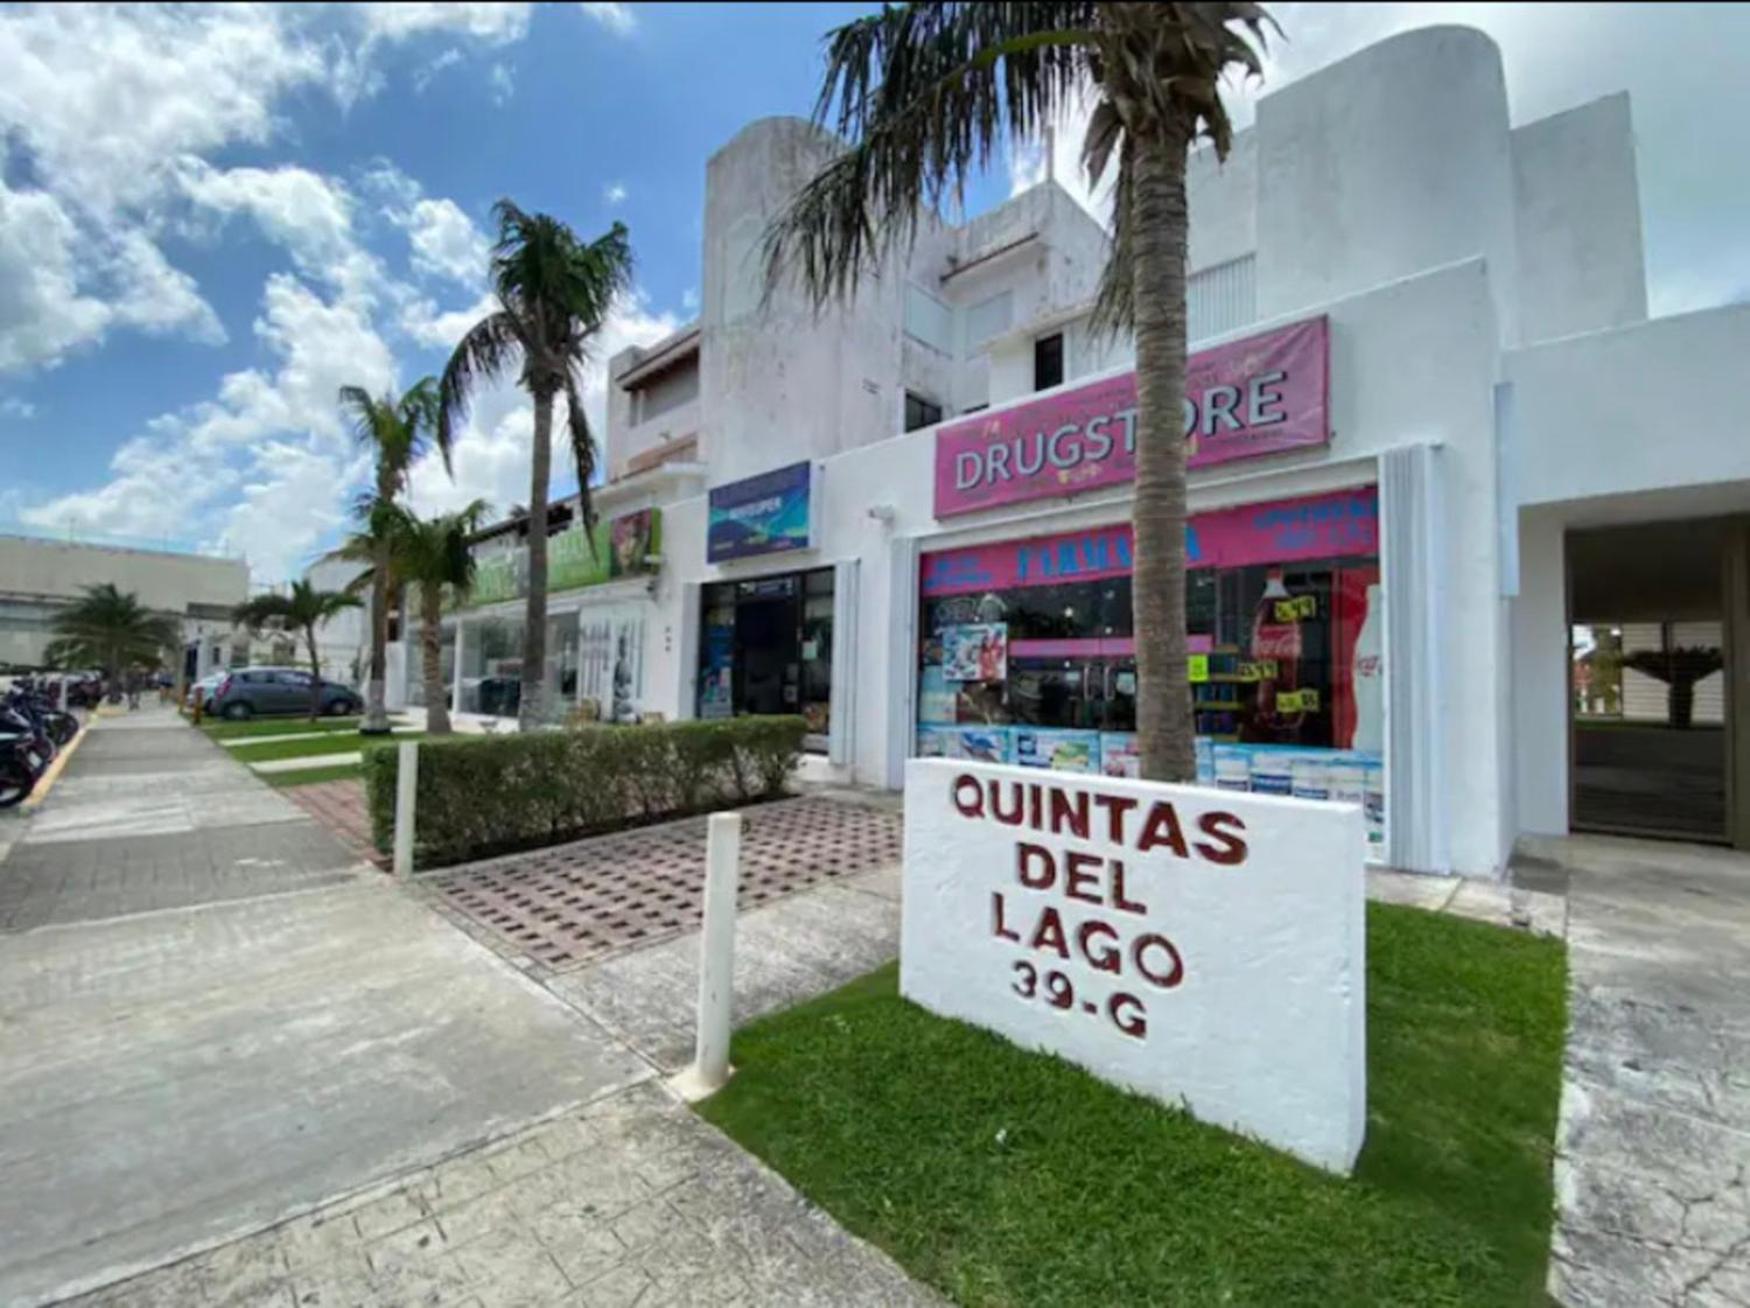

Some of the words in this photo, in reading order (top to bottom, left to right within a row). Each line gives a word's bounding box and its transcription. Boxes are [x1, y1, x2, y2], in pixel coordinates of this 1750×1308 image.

[952, 773, 1248, 866] QUINTAS
[1017, 841, 1147, 915] DEL
[991, 893, 1184, 988] LAGO
[1011, 960, 1147, 1039] 39-G
